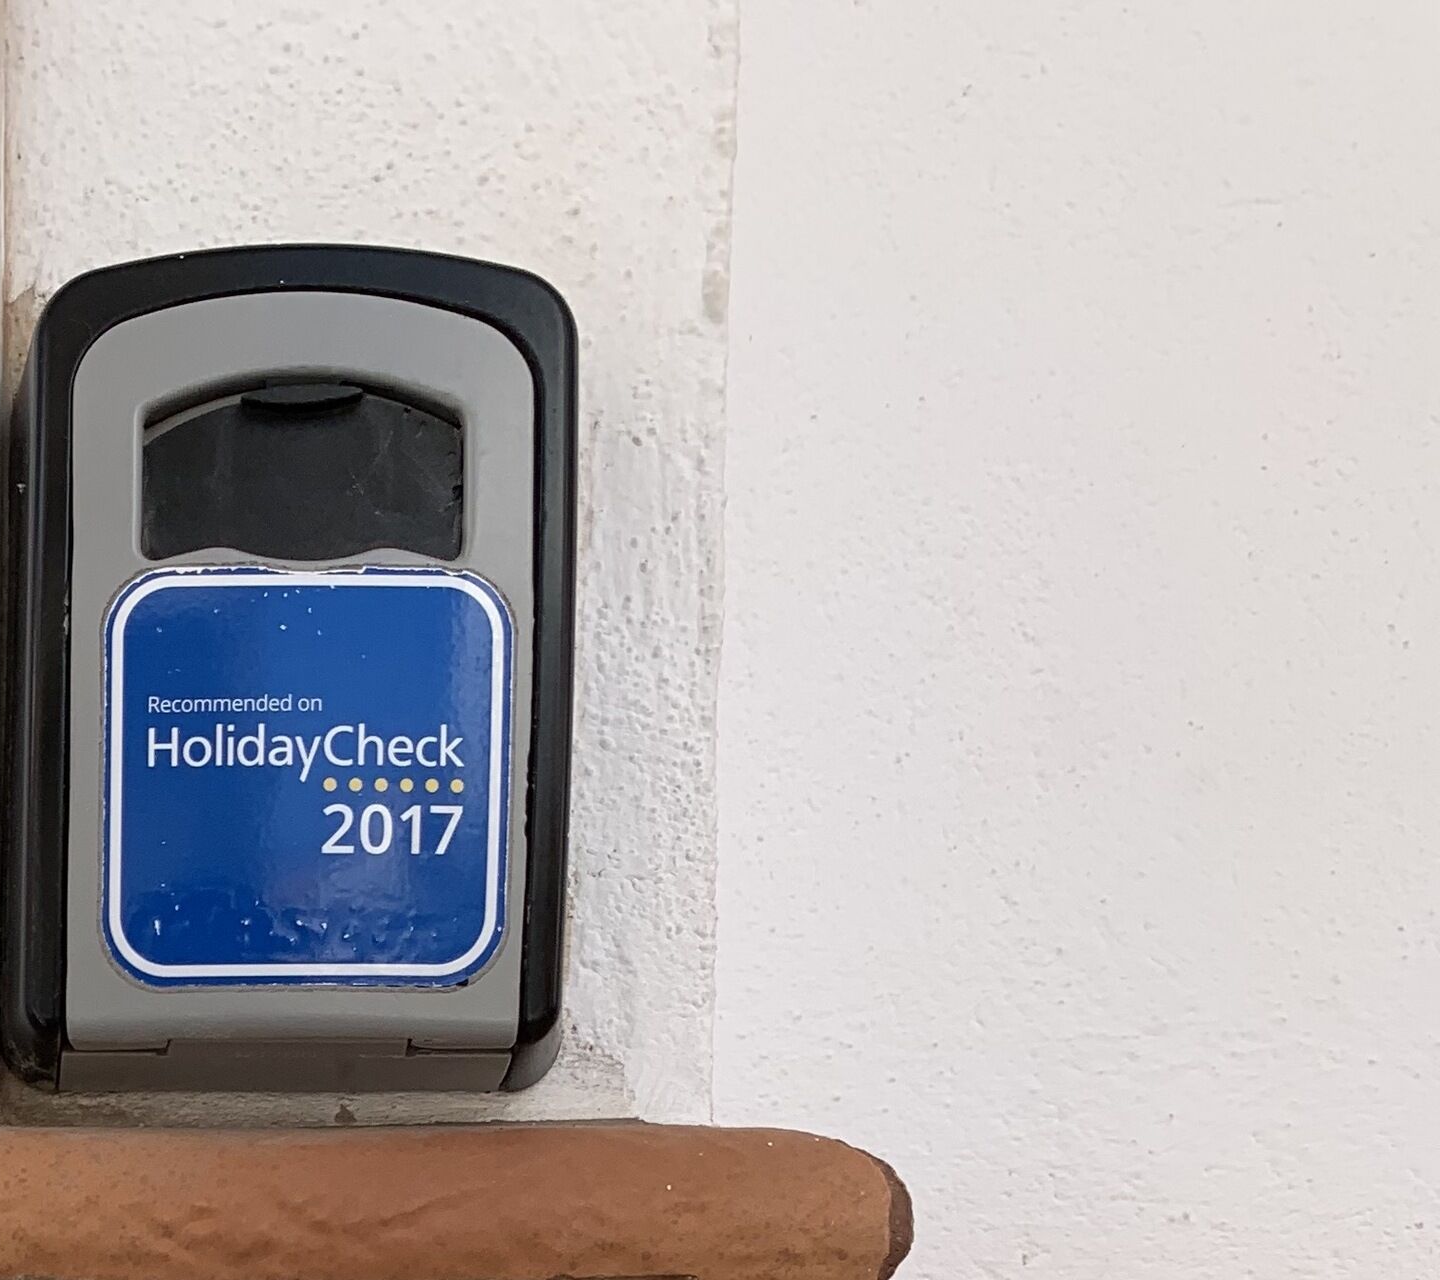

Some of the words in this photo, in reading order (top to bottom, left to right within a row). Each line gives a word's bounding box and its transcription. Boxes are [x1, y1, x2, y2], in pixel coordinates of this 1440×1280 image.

[148, 694, 293, 713] Recommended
[297, 698, 322, 712] on
[147, 723, 464, 783] HolidayCheck
[320, 803, 464, 855] 2017
